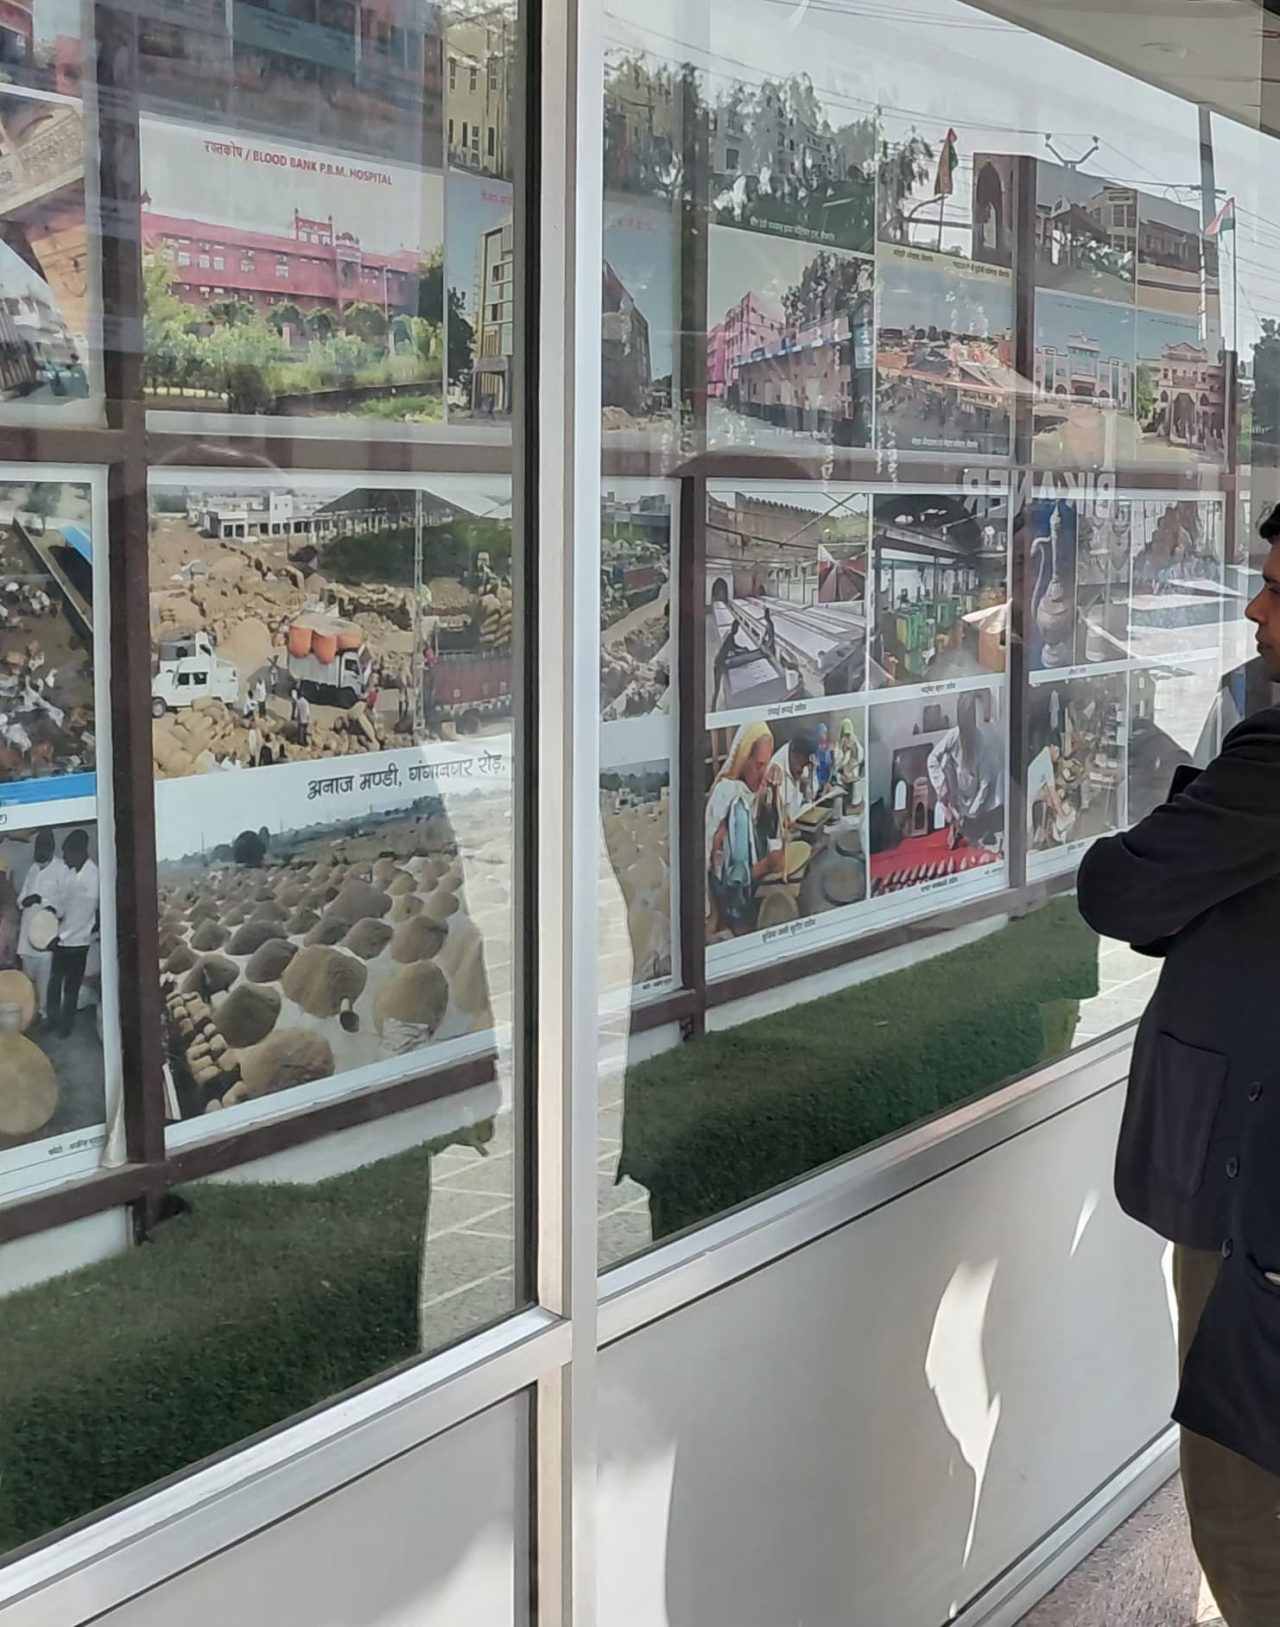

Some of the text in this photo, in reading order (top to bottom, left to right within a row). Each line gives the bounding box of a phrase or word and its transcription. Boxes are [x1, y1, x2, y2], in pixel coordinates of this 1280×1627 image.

[253, 150, 287, 167] BLOOD
[290, 157, 318, 172] BANK
[350, 168, 393, 185] HOSPITAL
[307, 775, 354, 800] अनाज
[408, 758, 473, 782] गंगानगर
